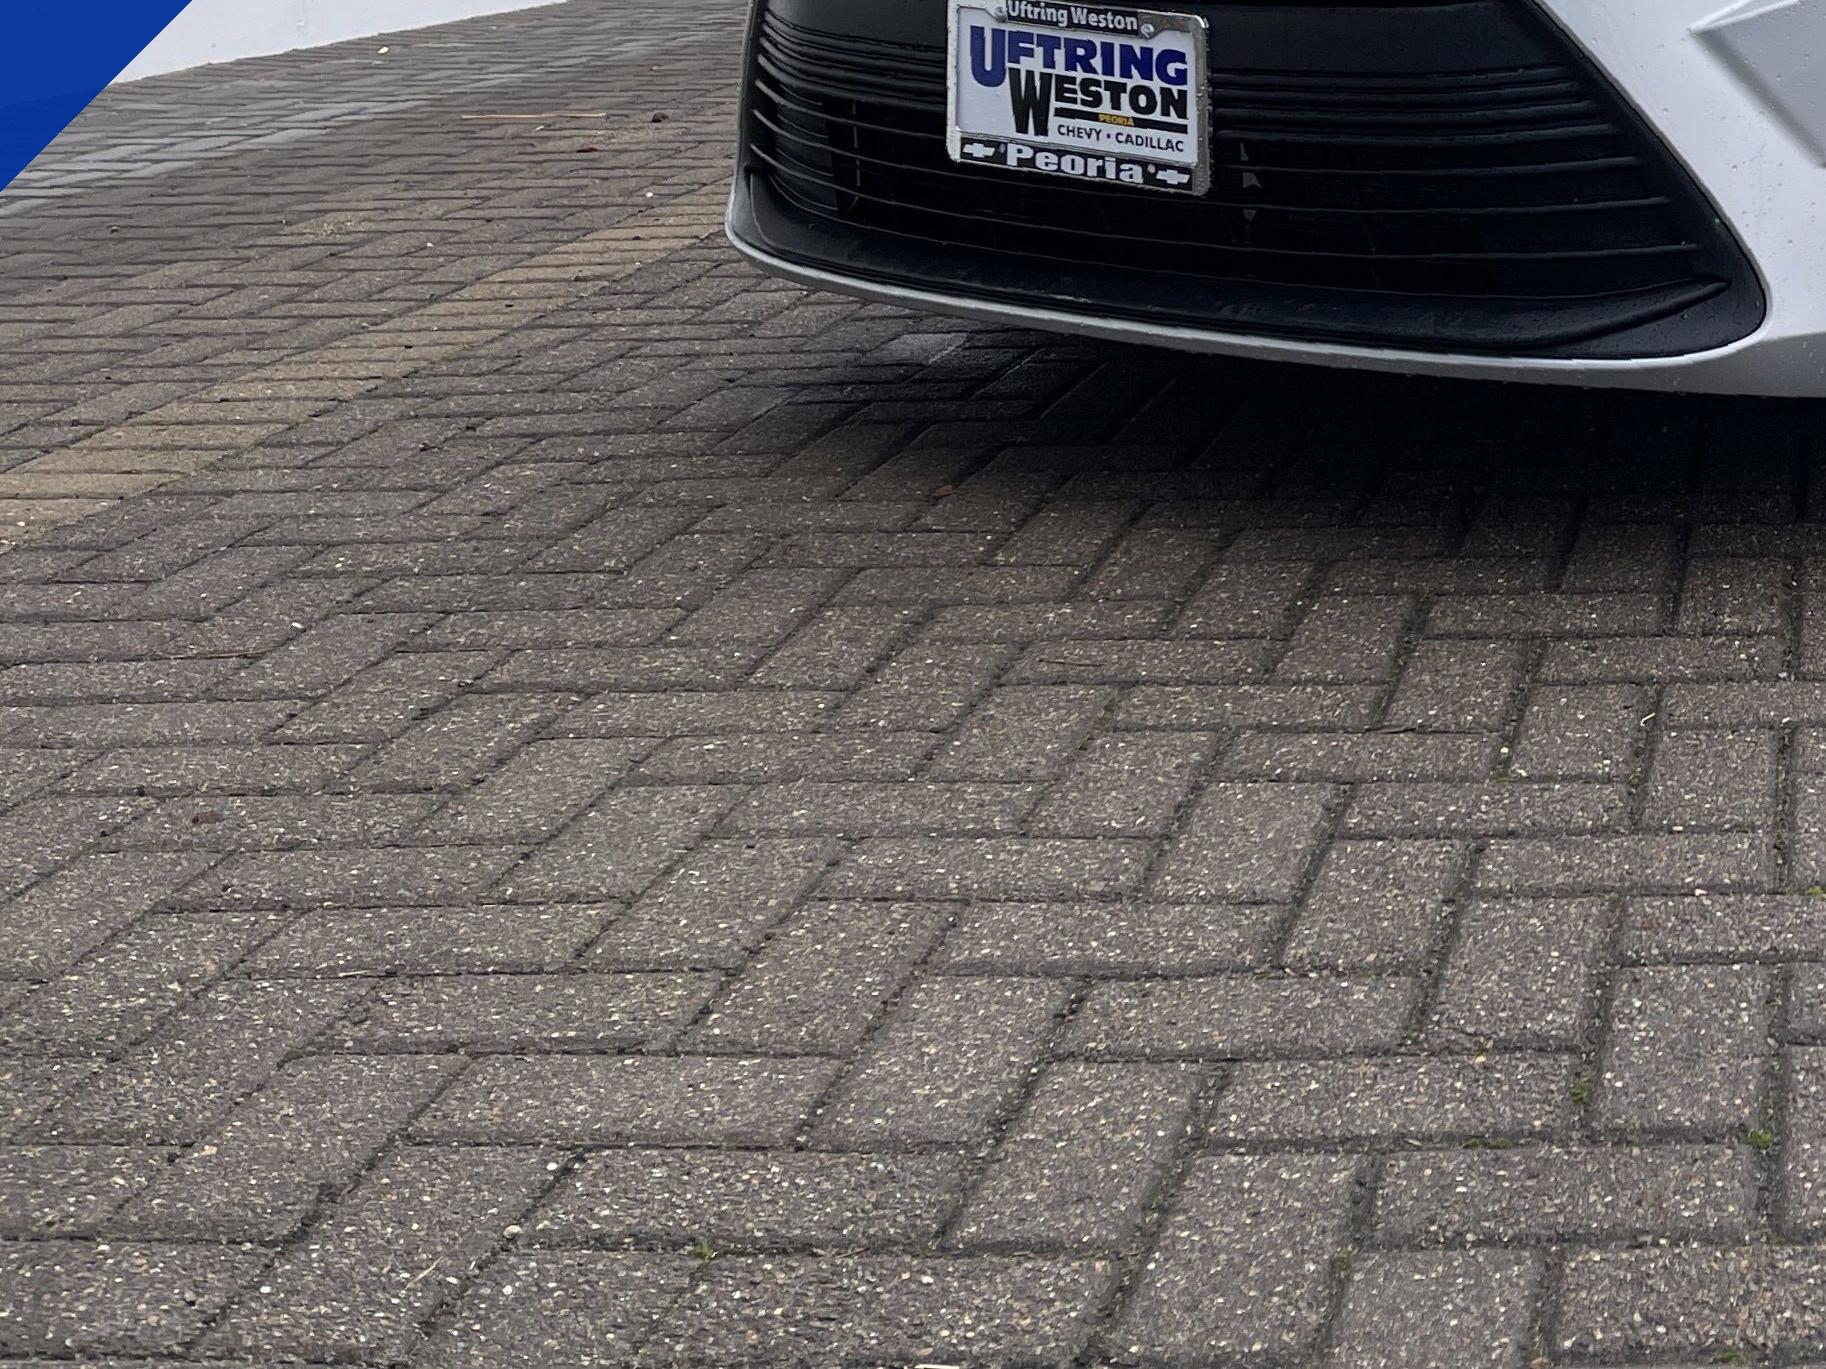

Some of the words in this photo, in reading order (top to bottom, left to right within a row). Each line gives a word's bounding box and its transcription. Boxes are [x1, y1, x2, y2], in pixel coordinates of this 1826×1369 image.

[1007, 0, 1068, 27] Uftring
[1072, 6, 1138, 31] Weston
[970, 25, 1189, 88] UFTRING
[1008, 67, 1189, 137] WESTON
[1098, 113, 1136, 127] PEORIA
[1057, 124, 1102, 142] CHEVY
[1115, 131, 1185, 153] CADILLAC
[1006, 142, 1144, 184] Peoria
